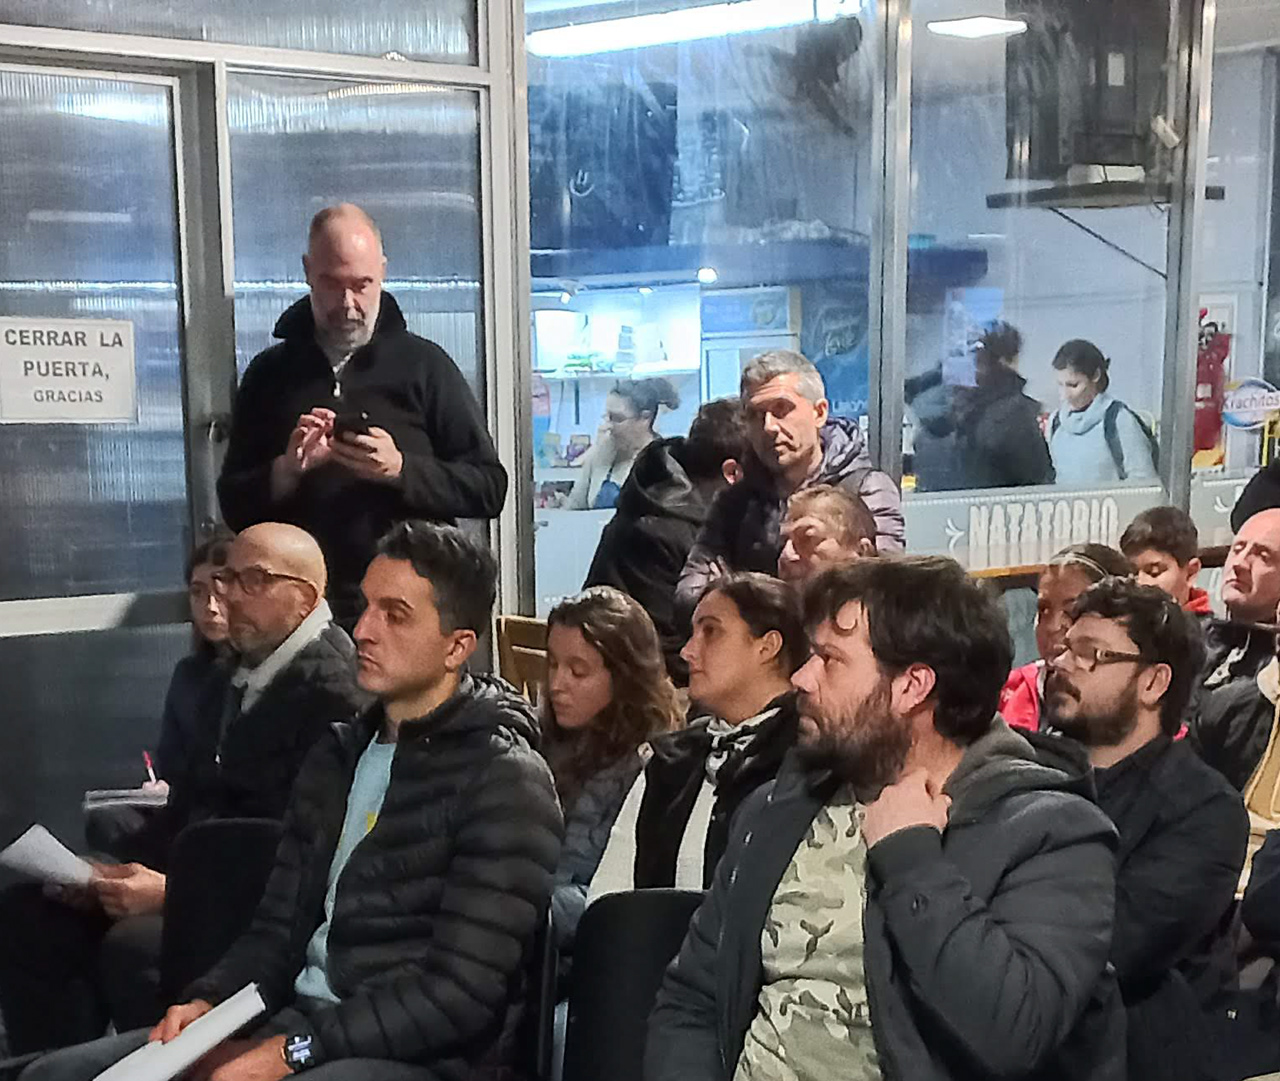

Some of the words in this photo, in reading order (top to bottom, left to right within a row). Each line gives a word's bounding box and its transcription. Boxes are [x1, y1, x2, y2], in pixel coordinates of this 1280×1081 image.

[4, 329, 88, 347] CERRAR
[99, 331, 124, 347] LA
[23, 360, 110, 380] PUERTA,
[33, 390, 104, 403] GRACIAS
[968, 497, 1119, 567] NATATORIO
